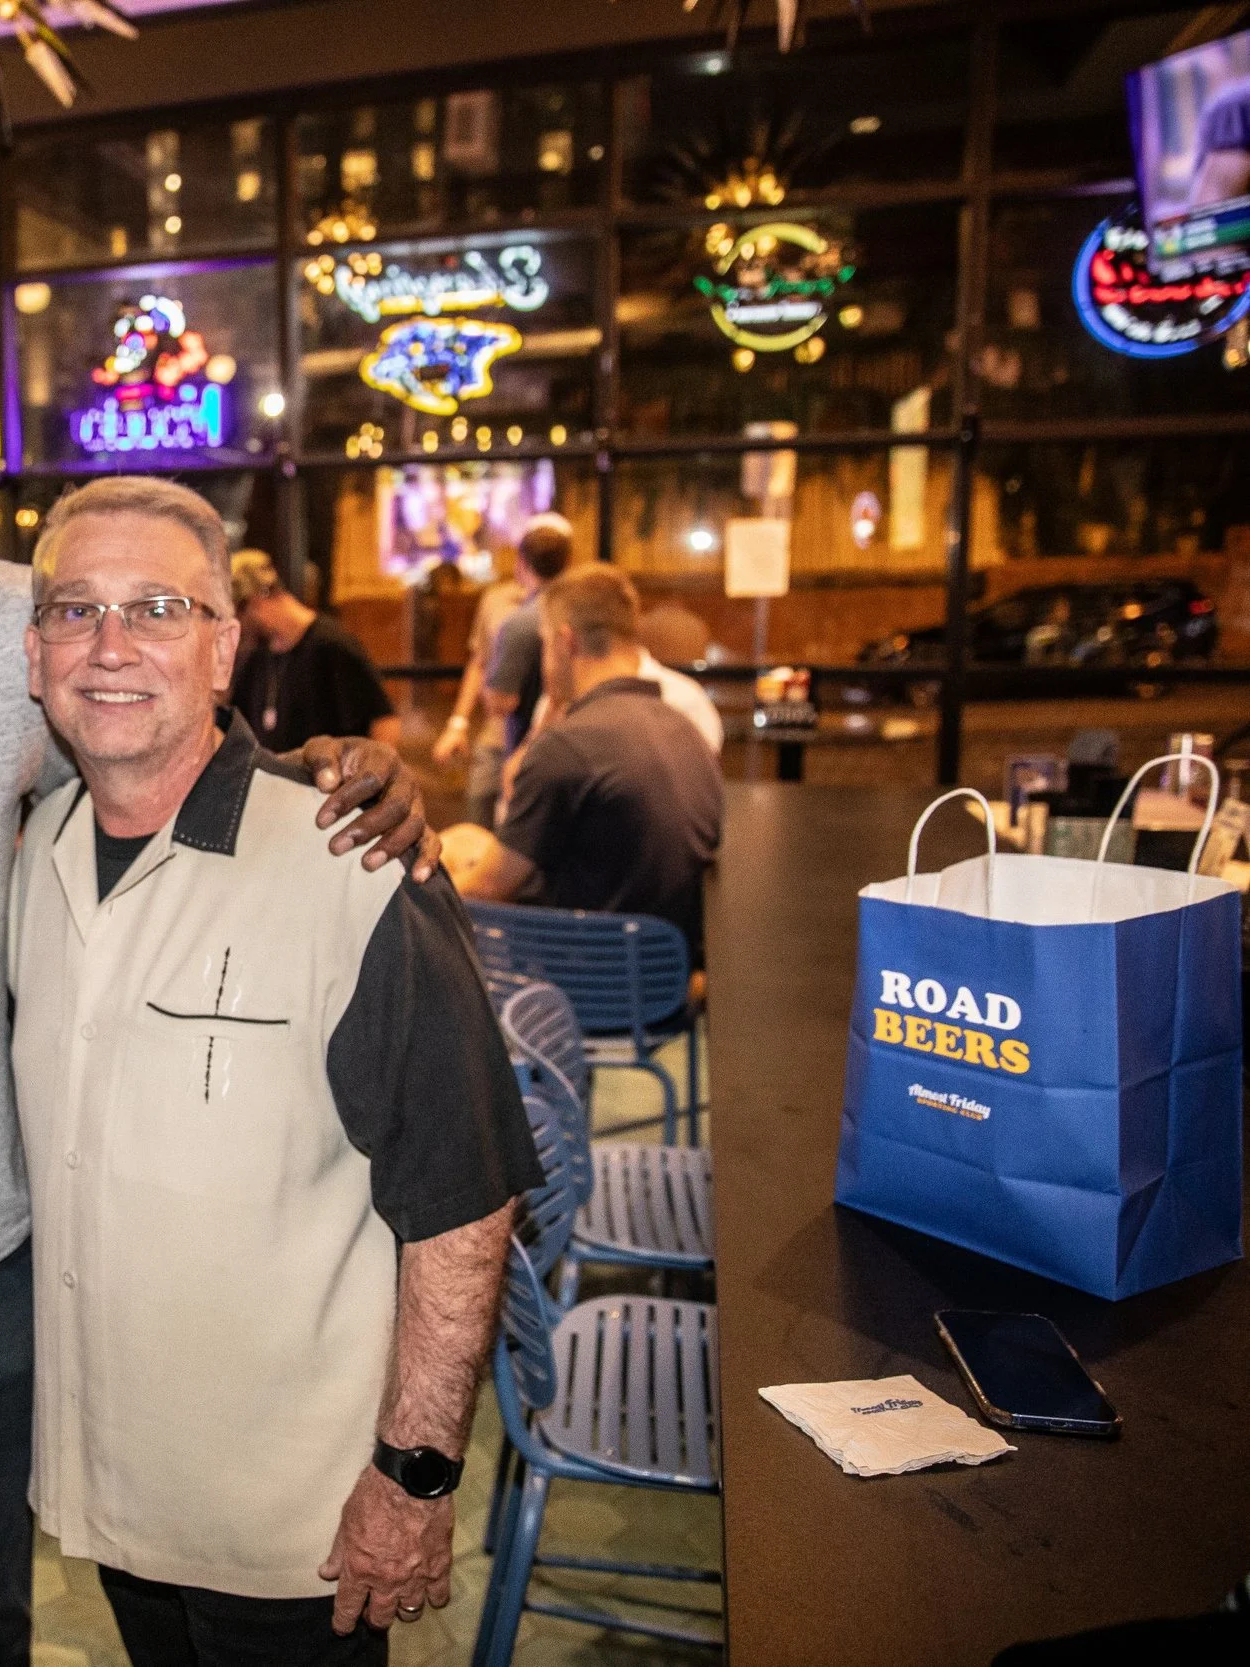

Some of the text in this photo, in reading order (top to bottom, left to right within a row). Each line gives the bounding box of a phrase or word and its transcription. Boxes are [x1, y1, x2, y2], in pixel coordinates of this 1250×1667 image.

[880, 969, 1022, 1031] ROAD
[873, 1007, 1031, 1075] BEERS
[948, 1093, 991, 1120] Friday
